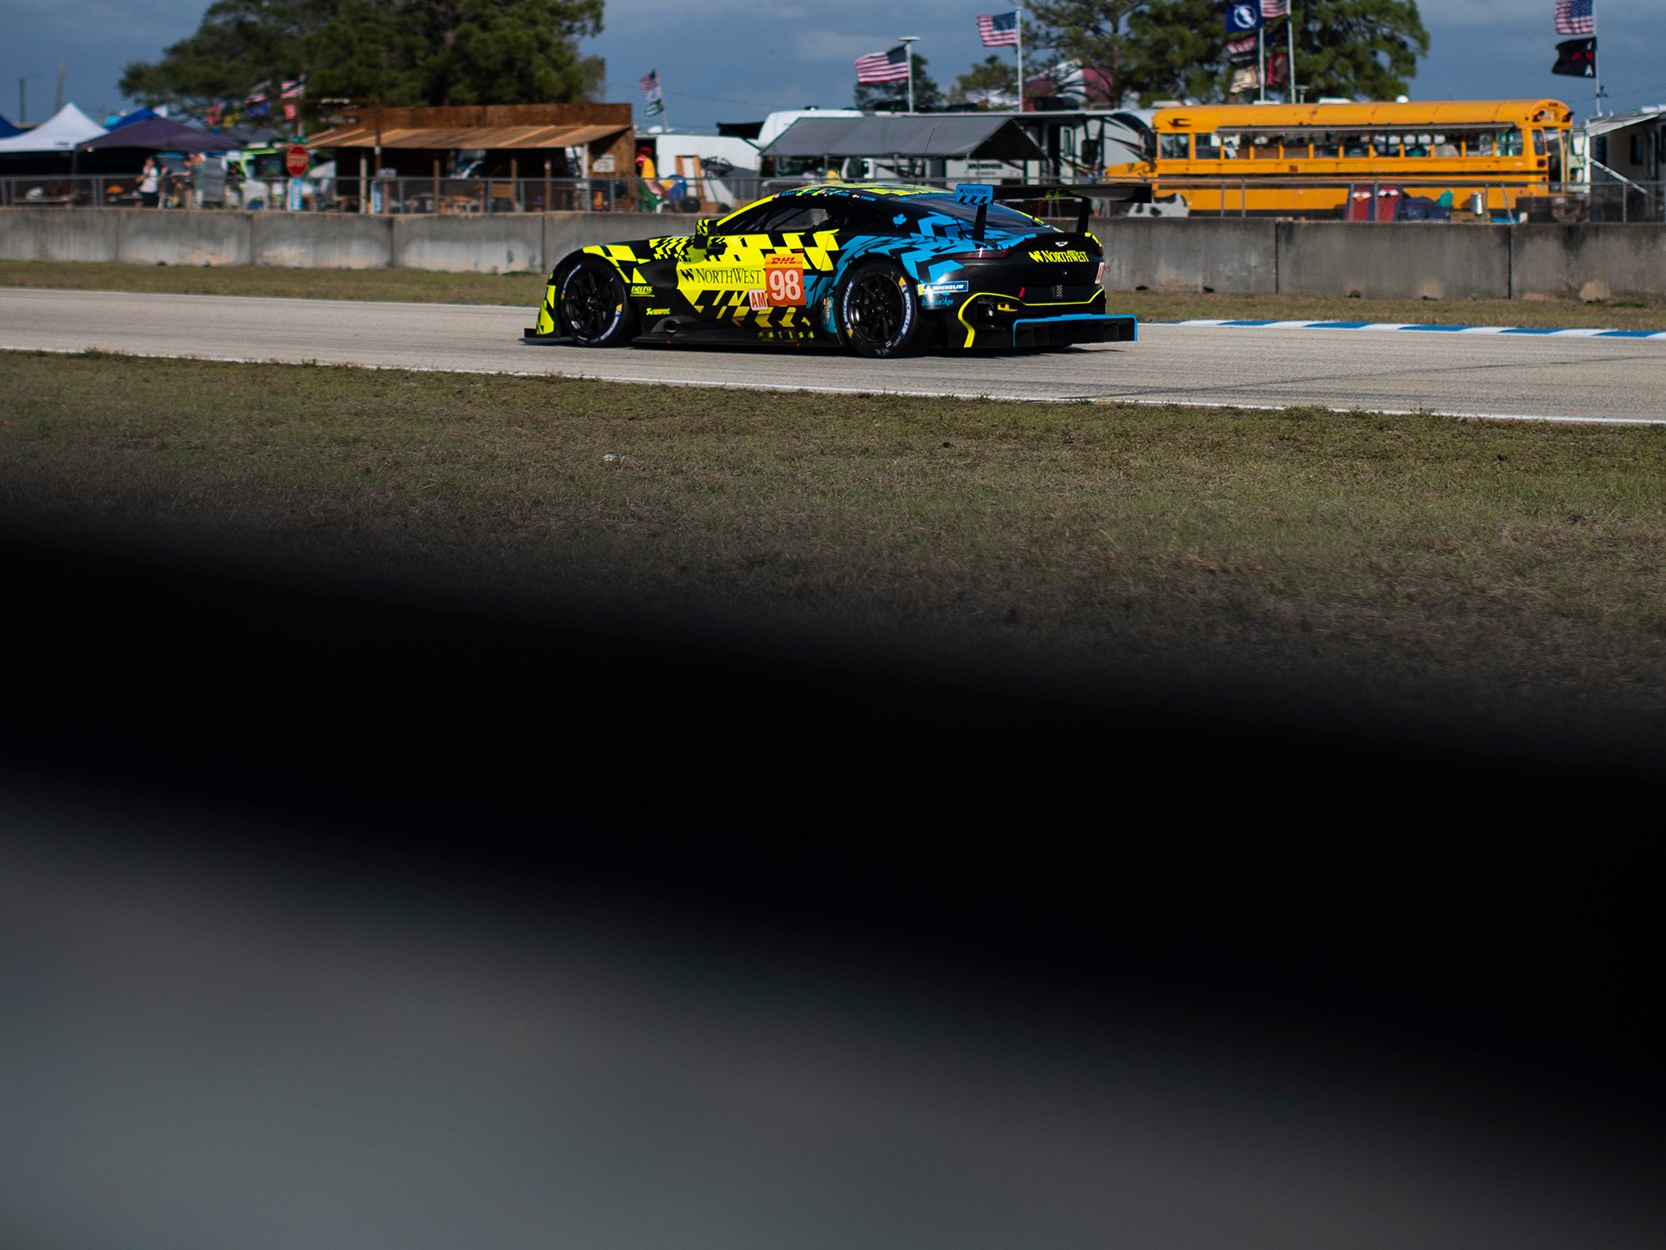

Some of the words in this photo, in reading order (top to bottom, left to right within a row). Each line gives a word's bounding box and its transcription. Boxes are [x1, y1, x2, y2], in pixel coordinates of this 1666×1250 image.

[771, 257, 796, 265] DHL
[769, 269, 801, 301] 98
[751, 291, 767, 308] AM
